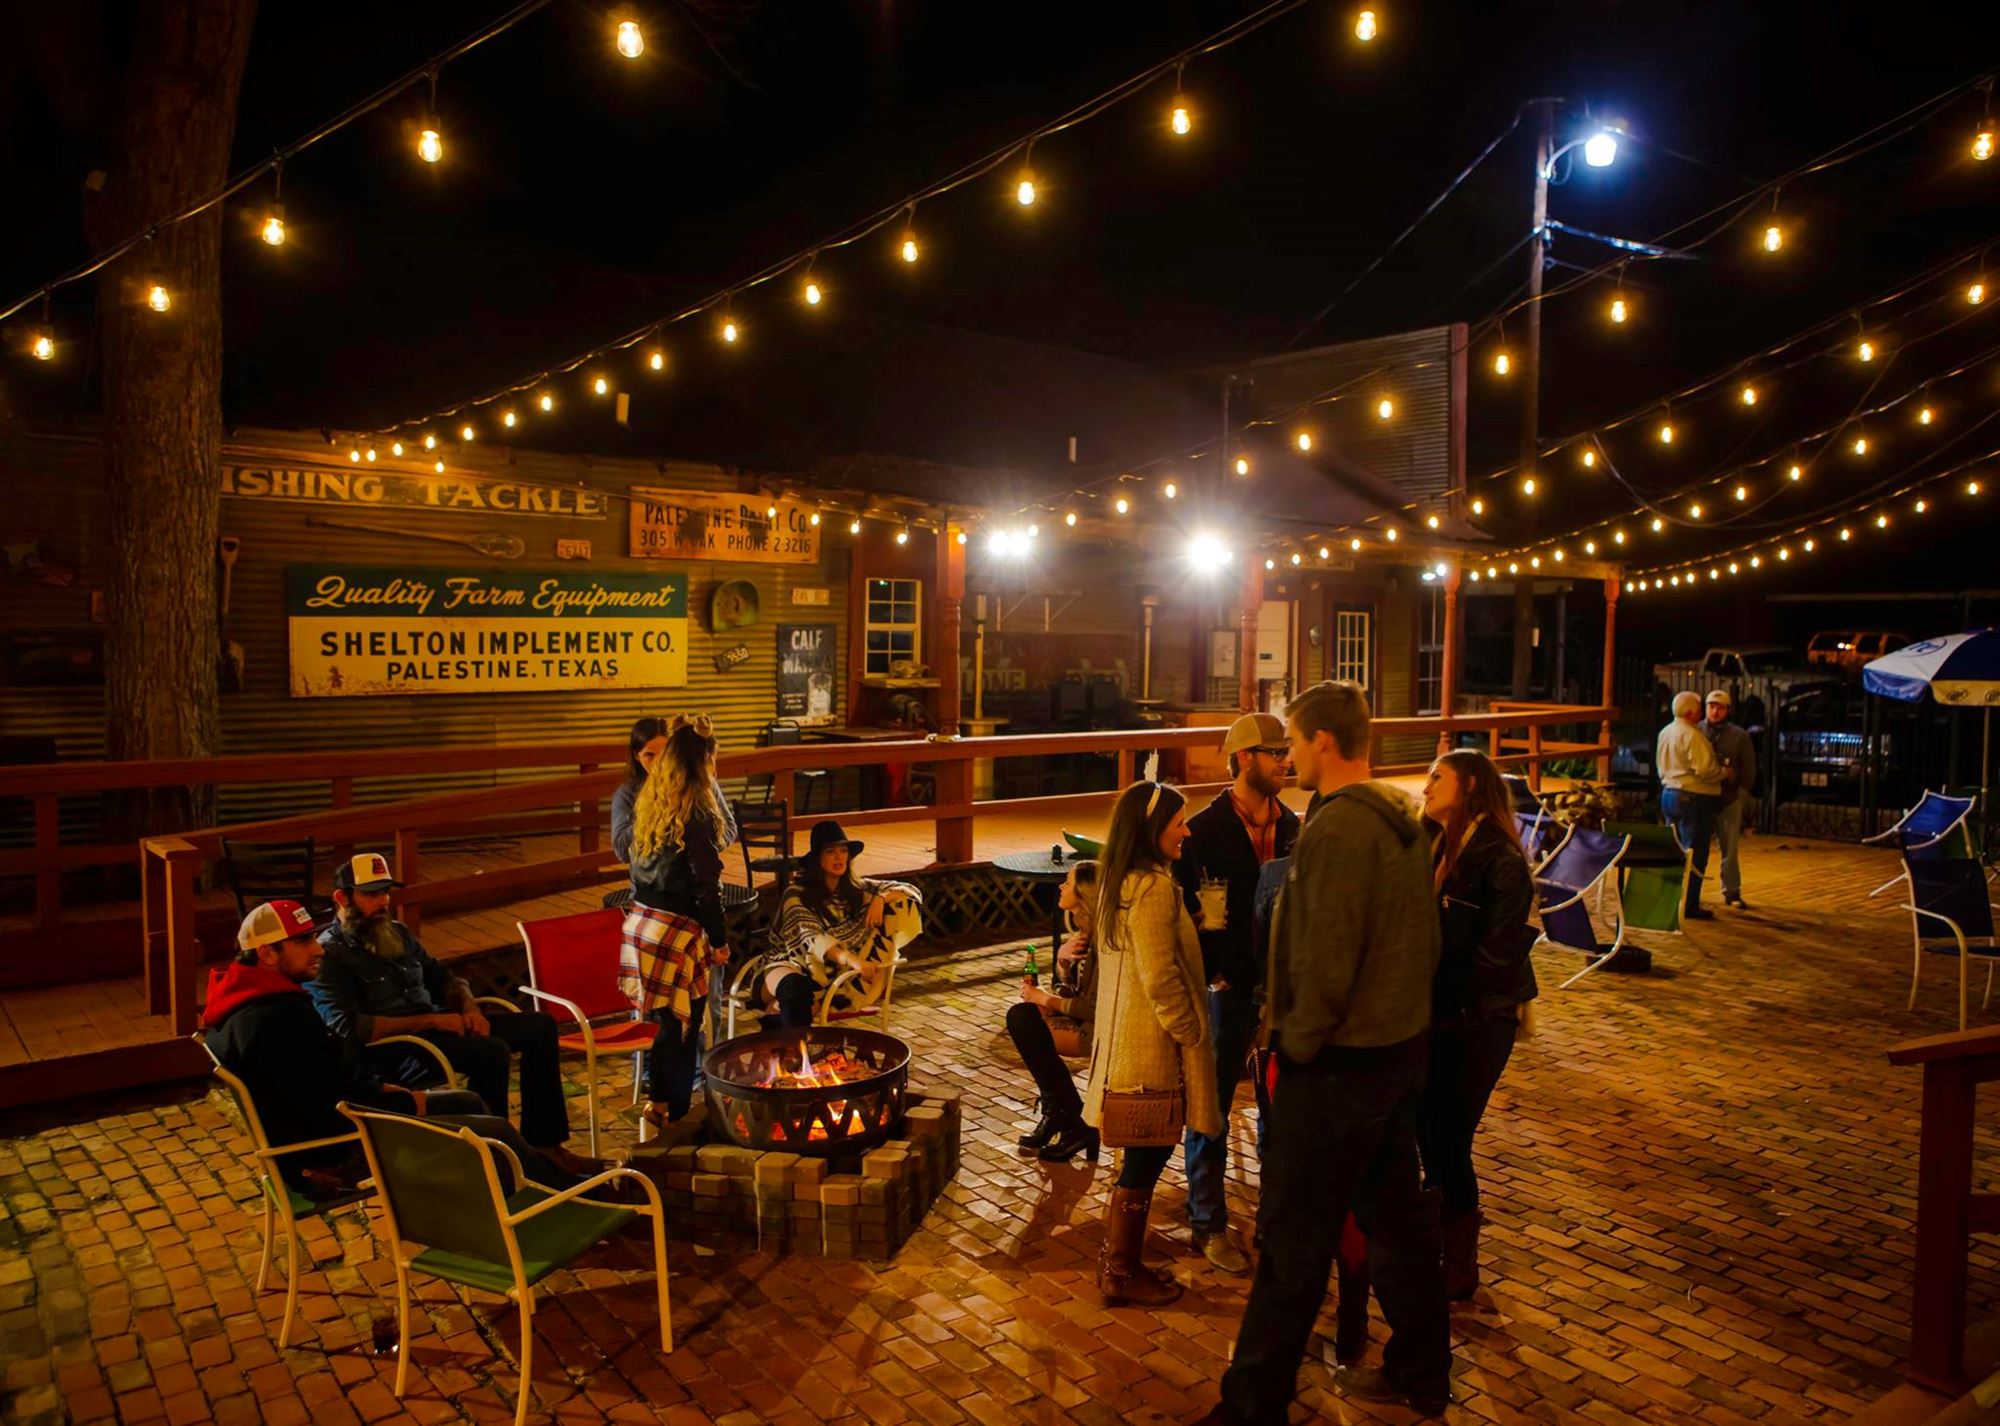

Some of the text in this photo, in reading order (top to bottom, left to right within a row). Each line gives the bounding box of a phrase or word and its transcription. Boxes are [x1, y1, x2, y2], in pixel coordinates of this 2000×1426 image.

[419, 479, 600, 514] TACKLE
[645, 503, 734, 529] PALEINE
[641, 529, 667, 547] 305
[728, 534, 768, 551] PHONE
[306, 576, 675, 616] Quality Farm Equipment
[320, 631, 675, 656] SHELTON IMPLEMENT CO.
[791, 630, 822, 651] CALF
[542, 659, 619, 678] TEXAS
